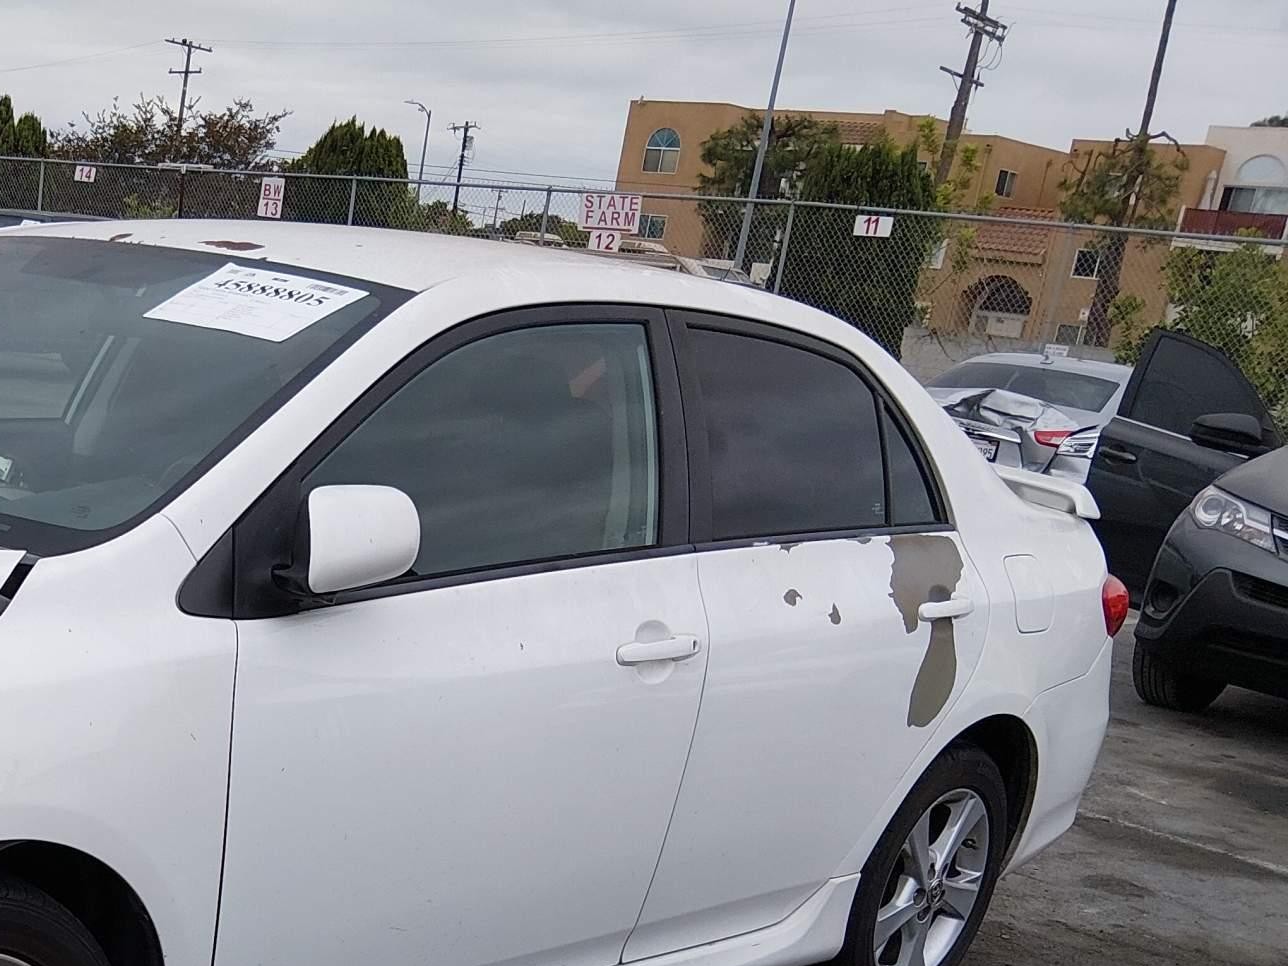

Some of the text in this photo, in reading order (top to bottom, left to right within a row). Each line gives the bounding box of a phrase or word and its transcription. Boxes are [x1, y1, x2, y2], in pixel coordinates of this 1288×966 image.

[79, 167, 92, 181] 14
[263, 183, 282, 197] BW
[263, 201, 278, 216] 13
[584, 194, 640, 212] STATE
[585, 210, 636, 226] FARM
[863, 216, 880, 235] 11
[595, 232, 616, 250] 12
[214, 278, 331, 307] 45888805
